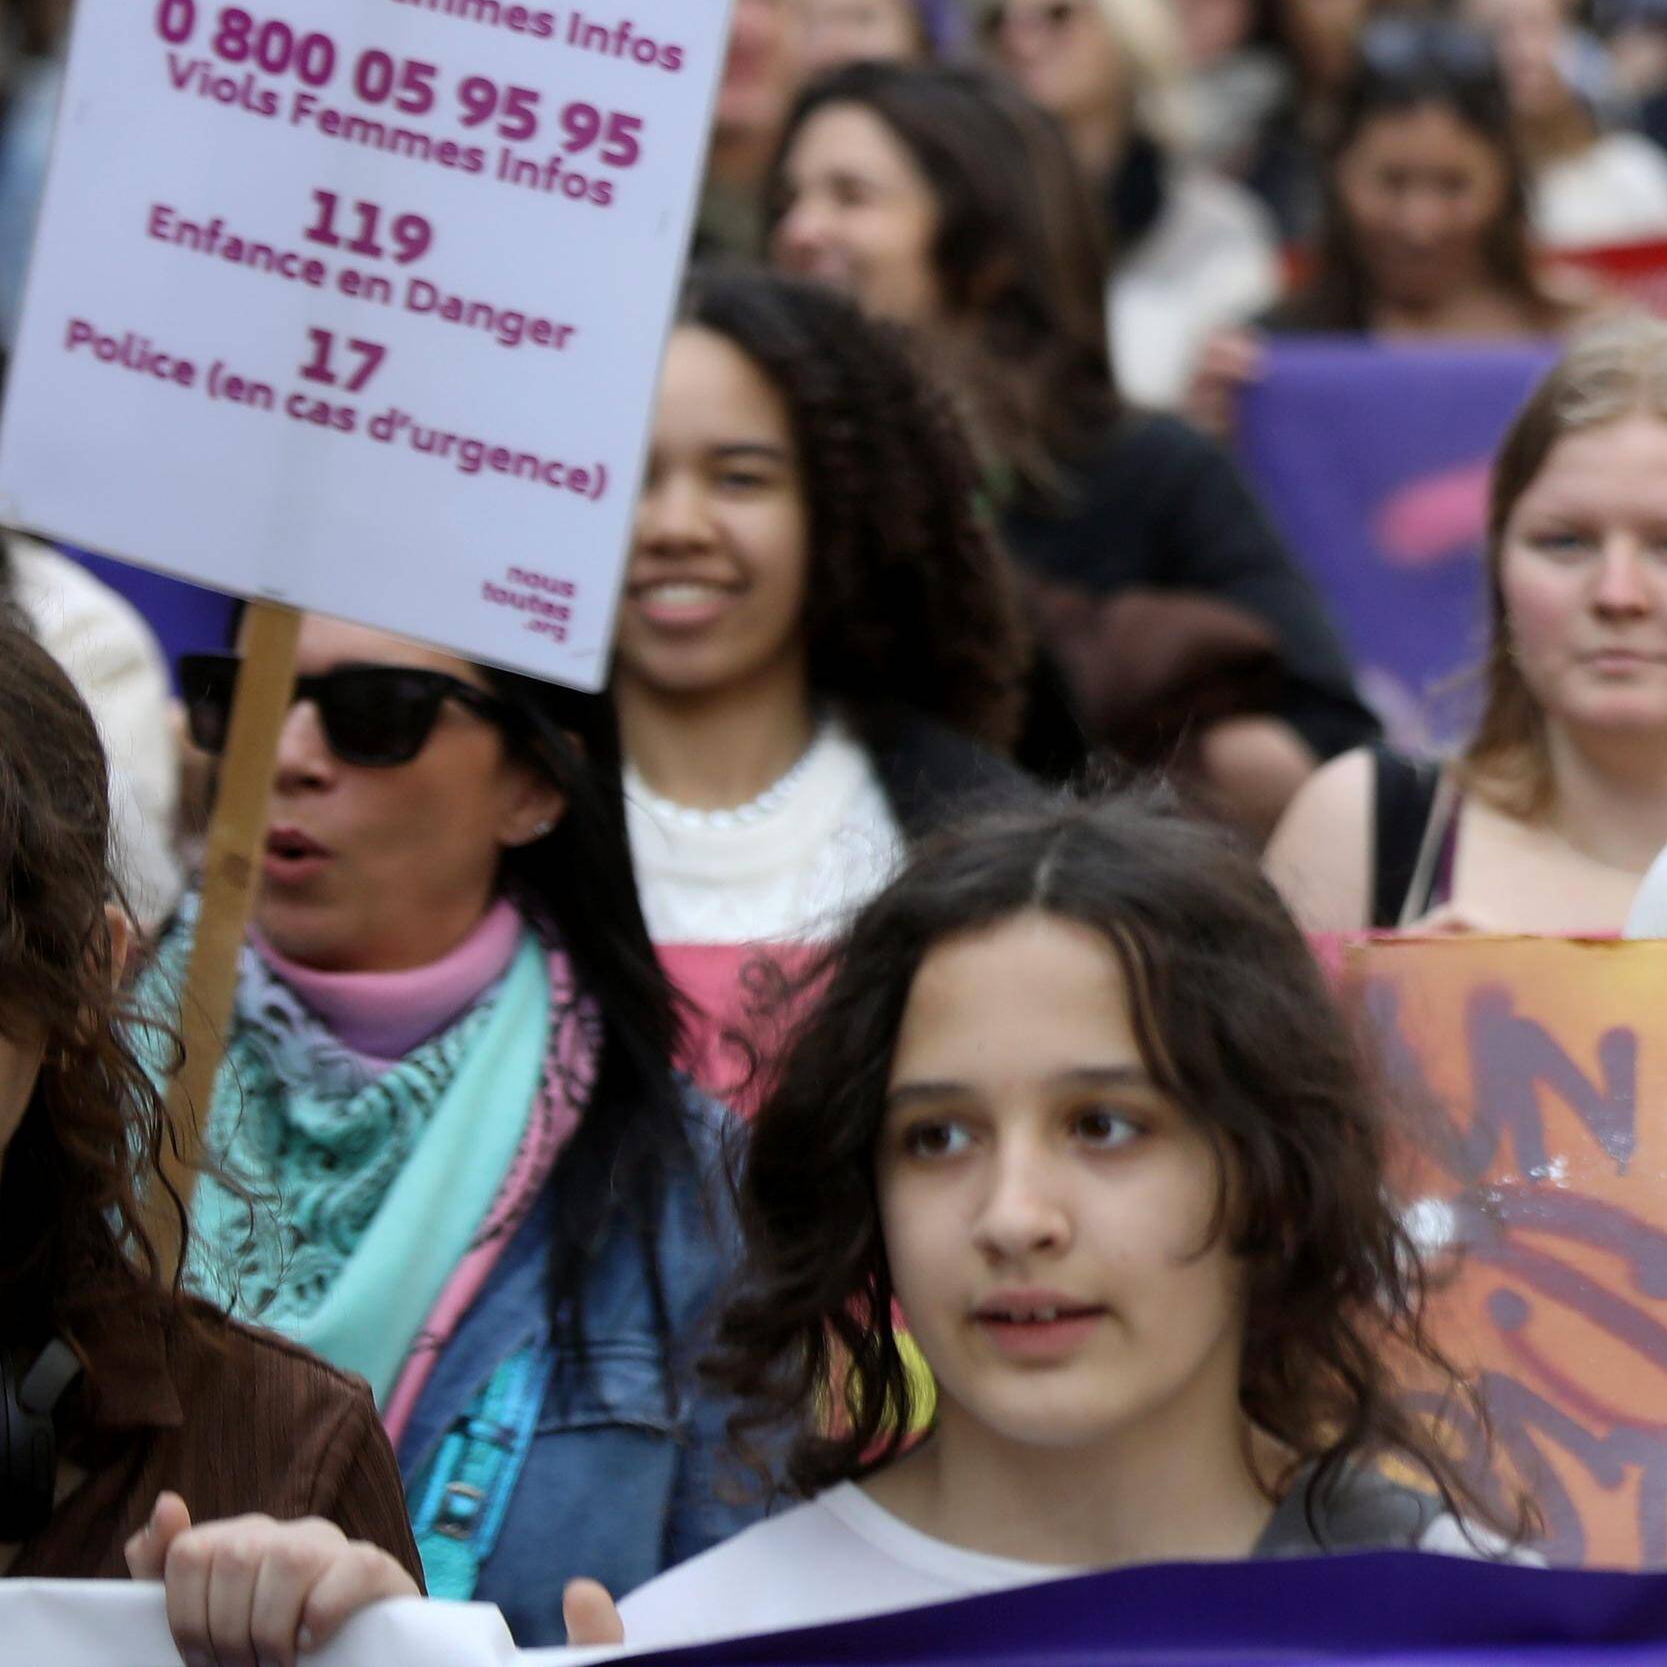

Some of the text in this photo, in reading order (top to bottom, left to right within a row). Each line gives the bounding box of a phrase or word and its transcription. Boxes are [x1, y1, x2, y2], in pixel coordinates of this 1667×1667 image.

[567, 11, 687, 74] Infos
[211, 4, 337, 89] 800
[353, 51, 437, 117] 05
[456, 74, 541, 145] 95
[558, 101, 645, 171] 95
[167, 52, 617, 209] Viols Femmes Infos
[304, 189, 434, 266] 119
[147, 204, 576, 354] Enfance en Danger
[298, 327, 389, 395] 17
[64, 319, 608, 502] Police (en cas d'urgence)
[481, 580, 573, 623] toutes
[508, 565, 578, 599] nous
